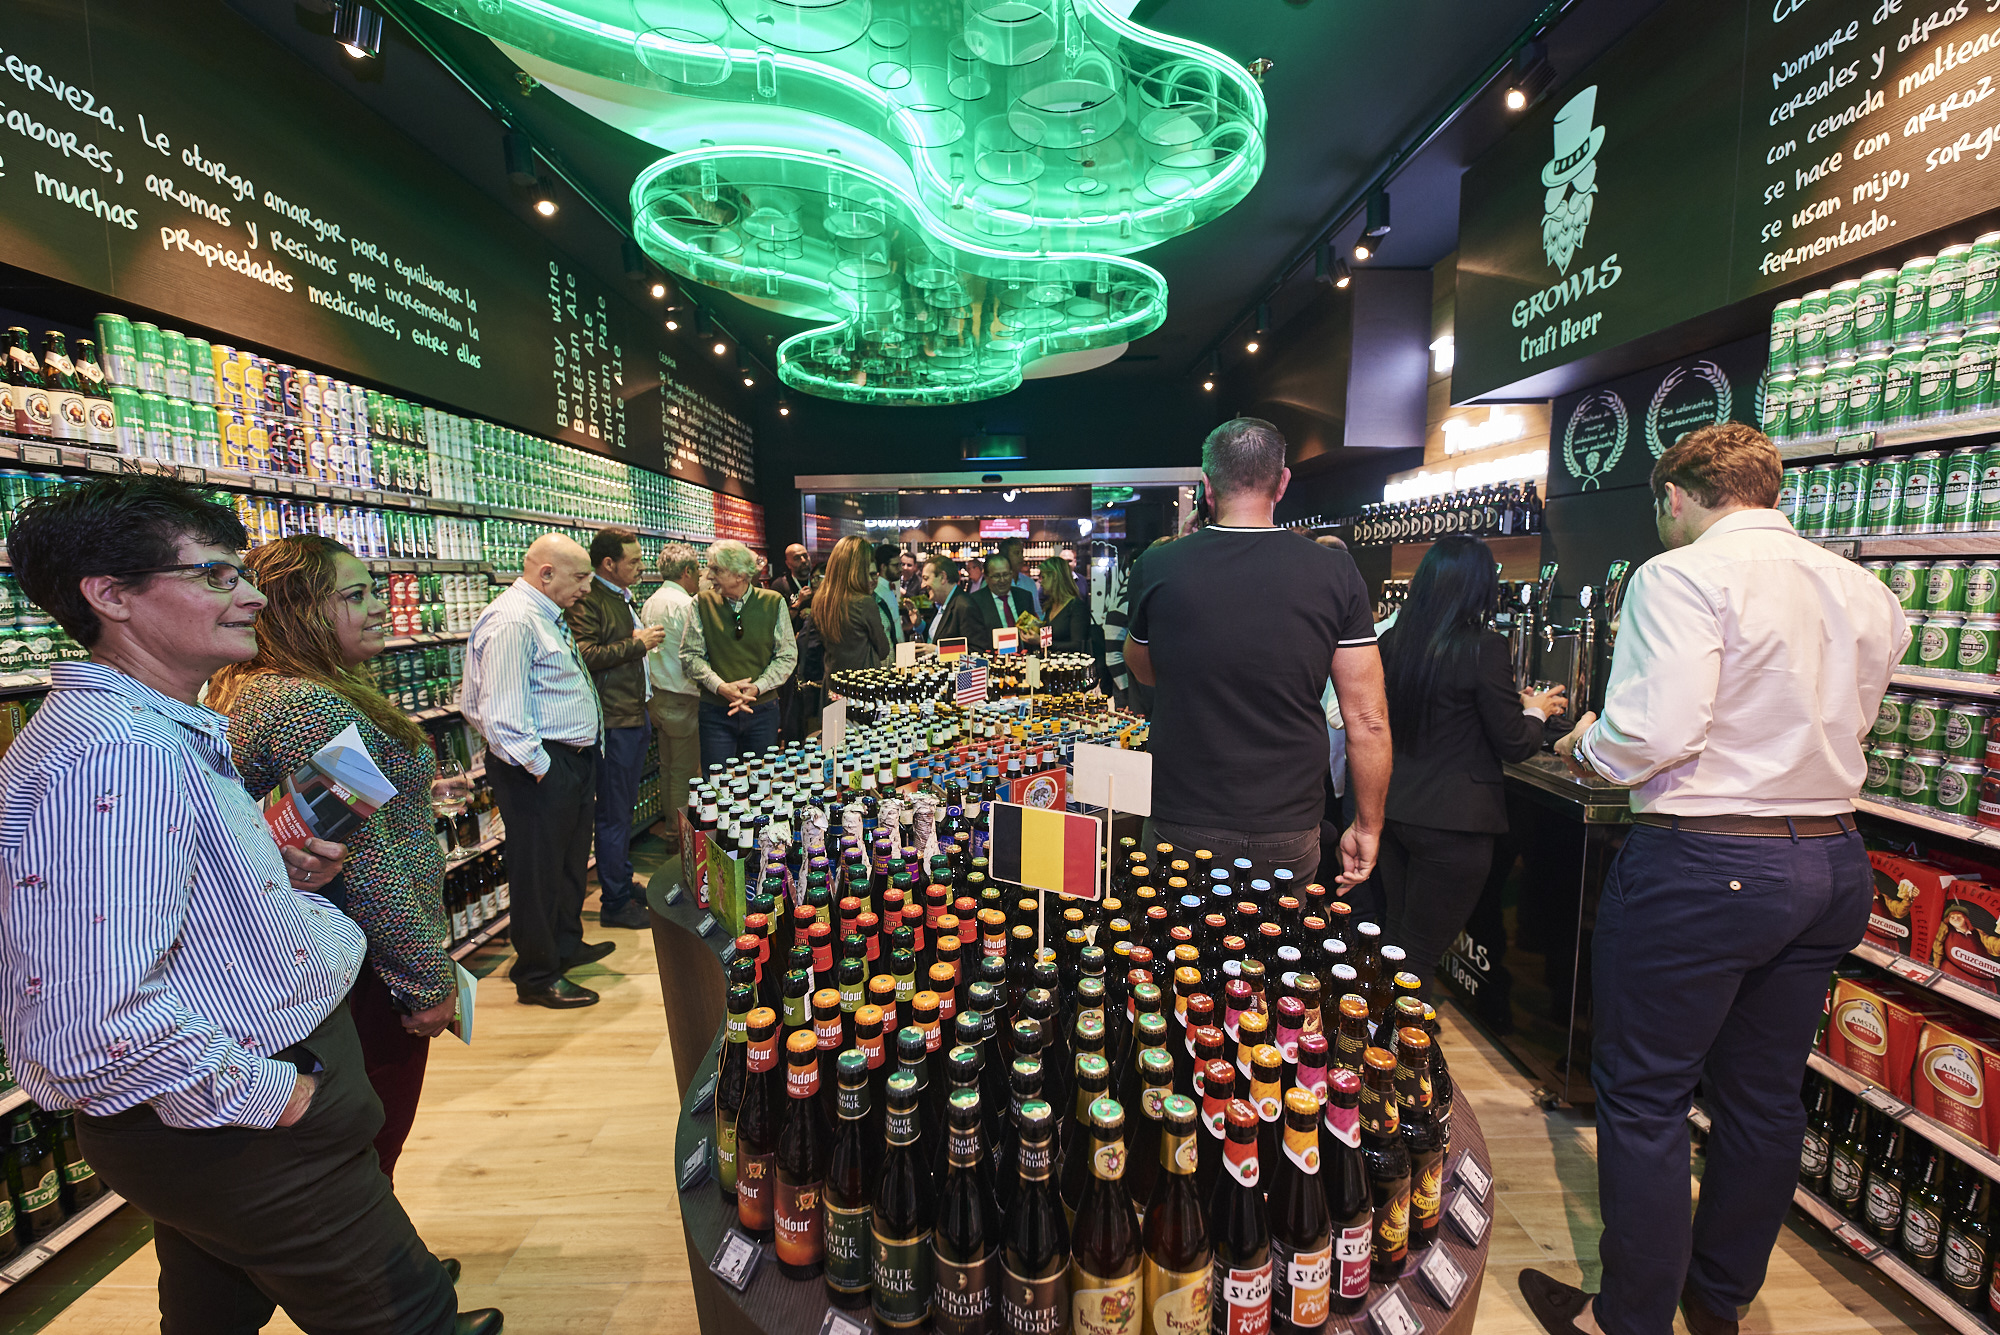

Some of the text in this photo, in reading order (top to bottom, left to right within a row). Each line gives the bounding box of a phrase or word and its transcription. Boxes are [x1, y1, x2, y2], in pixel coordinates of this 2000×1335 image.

[1870, 46, 1885, 80] y
[1766, 138, 1796, 165] con
[1806, 88, 1885, 144] cebada
[1764, 180, 1785, 205] se
[1795, 152, 1843, 190] hace
[1852, 131, 1890, 161] con
[1760, 219, 1782, 244] se
[1792, 195, 1841, 229] usan
[1852, 168, 1910, 205] mijo,
[34, 171, 138, 230] muchas
[308, 286, 400, 340] medicinales,
[457, 343, 482, 369] ellas
[246, 220, 258, 250] y
[348, 272, 376, 294] que
[468, 318, 479, 342] la
[466, 288, 478, 312] la
[1510, 253, 1623, 328] GROWLS
[550, 261, 568, 427] Barley wine
[565, 274, 584, 434] Belgian Ale
[596, 296, 614, 443] Indian Pale
[1520, 311, 1603, 363] Craft Beer
[583, 312, 600, 439] Brown Ale
[613, 345, 626, 448] Pale Ale
[1661, 407, 1674, 418] Sin
[1871, 855, 1905, 878] ABRICA
[1452, 956, 1478, 996] Beer
[1851, 1016, 1880, 1034] AMSTEL
[1854, 1025, 1876, 1039] CERVEZA
[1942, 1063, 1974, 1084] AMSTEL
[1944, 1073, 1970, 1090] CERVEZA
